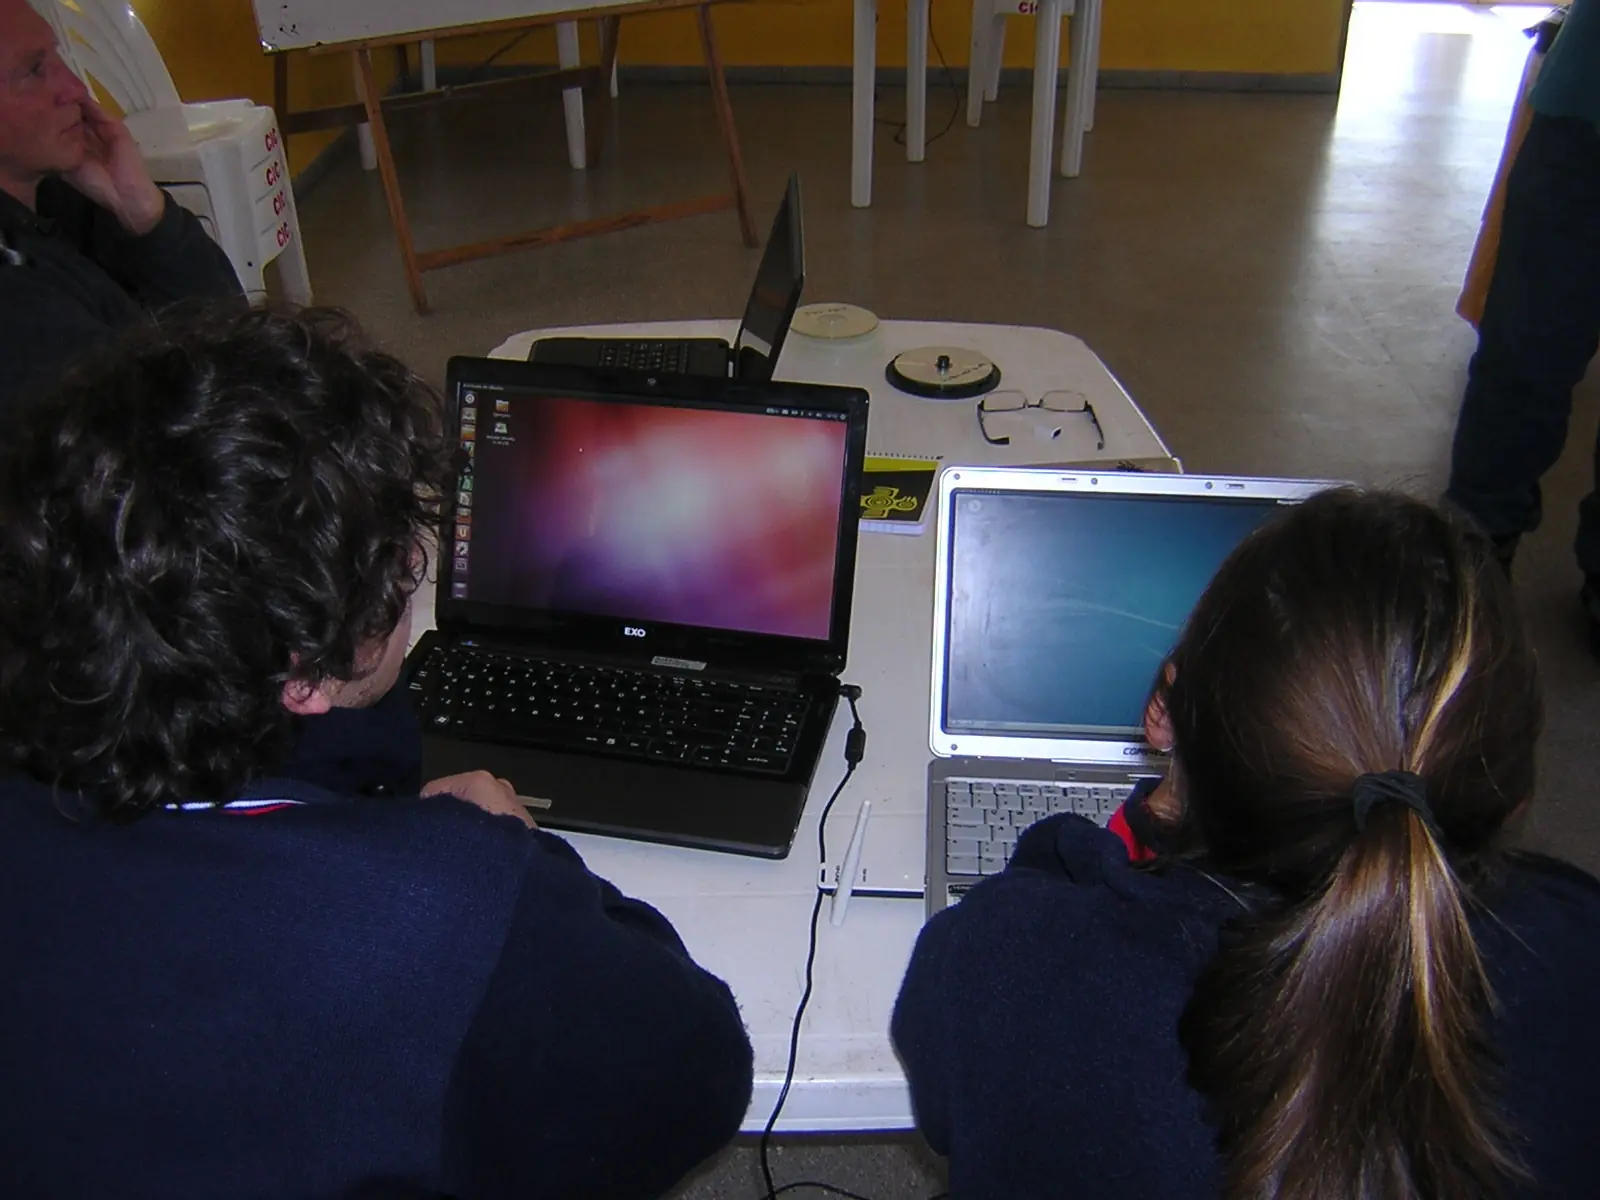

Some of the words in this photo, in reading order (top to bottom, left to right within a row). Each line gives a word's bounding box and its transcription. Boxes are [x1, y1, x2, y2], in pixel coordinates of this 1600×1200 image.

[265, 128, 277, 151] CIC
[266, 161, 280, 185] CIC
[624, 626, 646, 637] EXO
